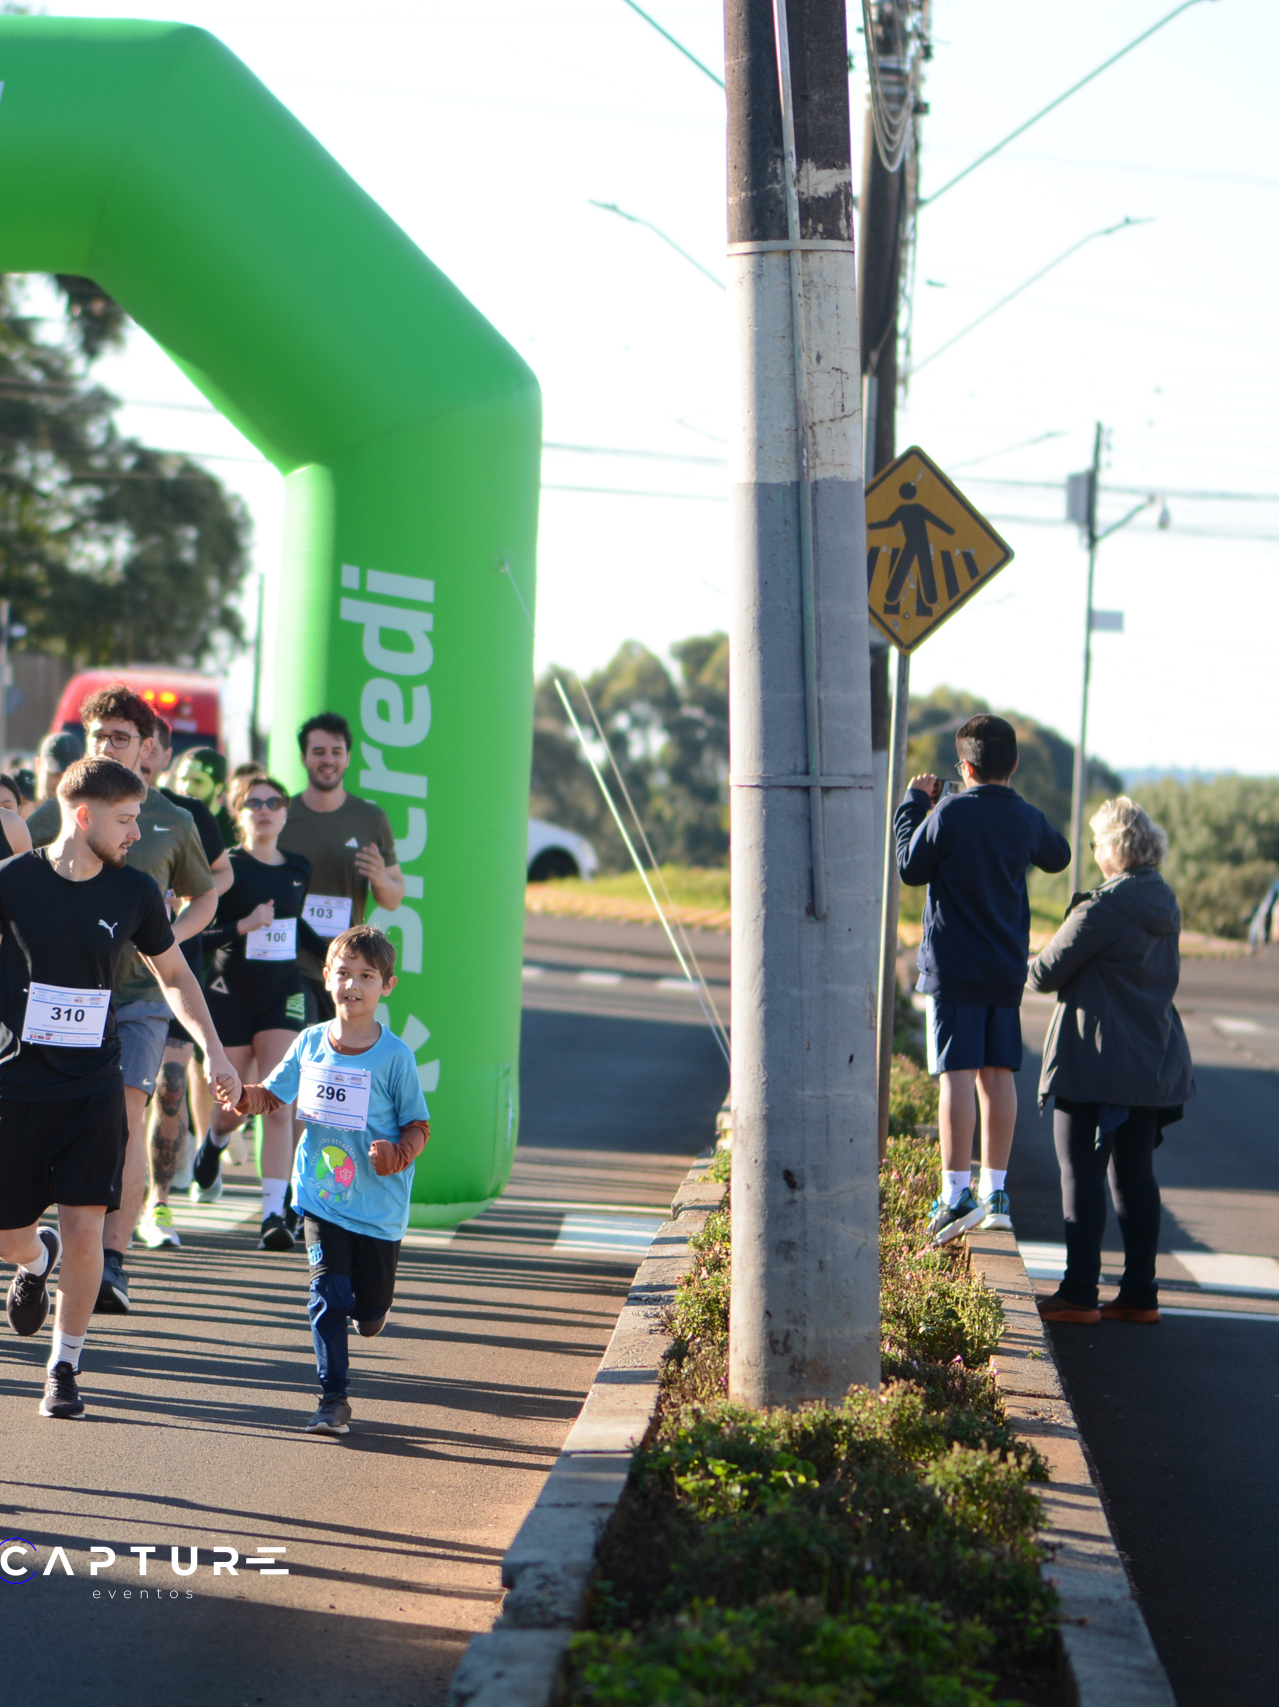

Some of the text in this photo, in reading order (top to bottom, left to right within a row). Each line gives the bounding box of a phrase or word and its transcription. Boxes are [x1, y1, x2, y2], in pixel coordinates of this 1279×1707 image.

[308, 907, 333, 919] 103
[265, 932, 287, 943] 100
[50, 1006, 85, 1023] 310
[316, 1084, 347, 1102] 296
